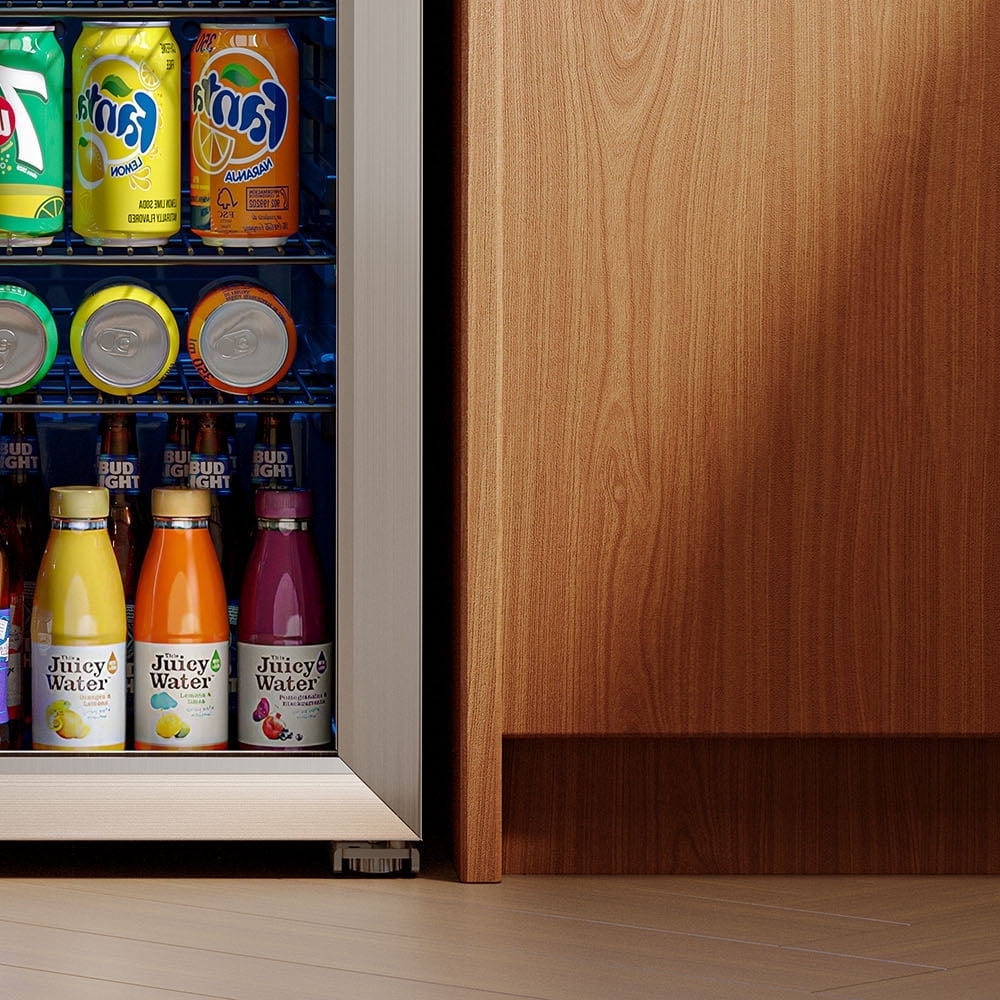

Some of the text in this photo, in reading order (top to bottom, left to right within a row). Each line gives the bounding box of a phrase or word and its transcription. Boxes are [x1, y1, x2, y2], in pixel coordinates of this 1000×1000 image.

[0, 456, 38, 469] IGHT
[164, 451, 191, 463] BU
[253, 450, 288, 463] BUD
[99, 461, 134, 475] BUD
[189, 462, 225, 475] BUD
[251, 464, 293, 477] IGHT
[99, 475, 140, 488] IGHT
[188, 475, 230, 488] IGHT
[48, 656, 106, 677] Juicy
[152, 655, 209, 676] Juicy
[257, 657, 316, 678] Juicy
[46, 674, 108, 692] Water
[150, 672, 211, 689] Water
[256, 675, 317, 691] Water
